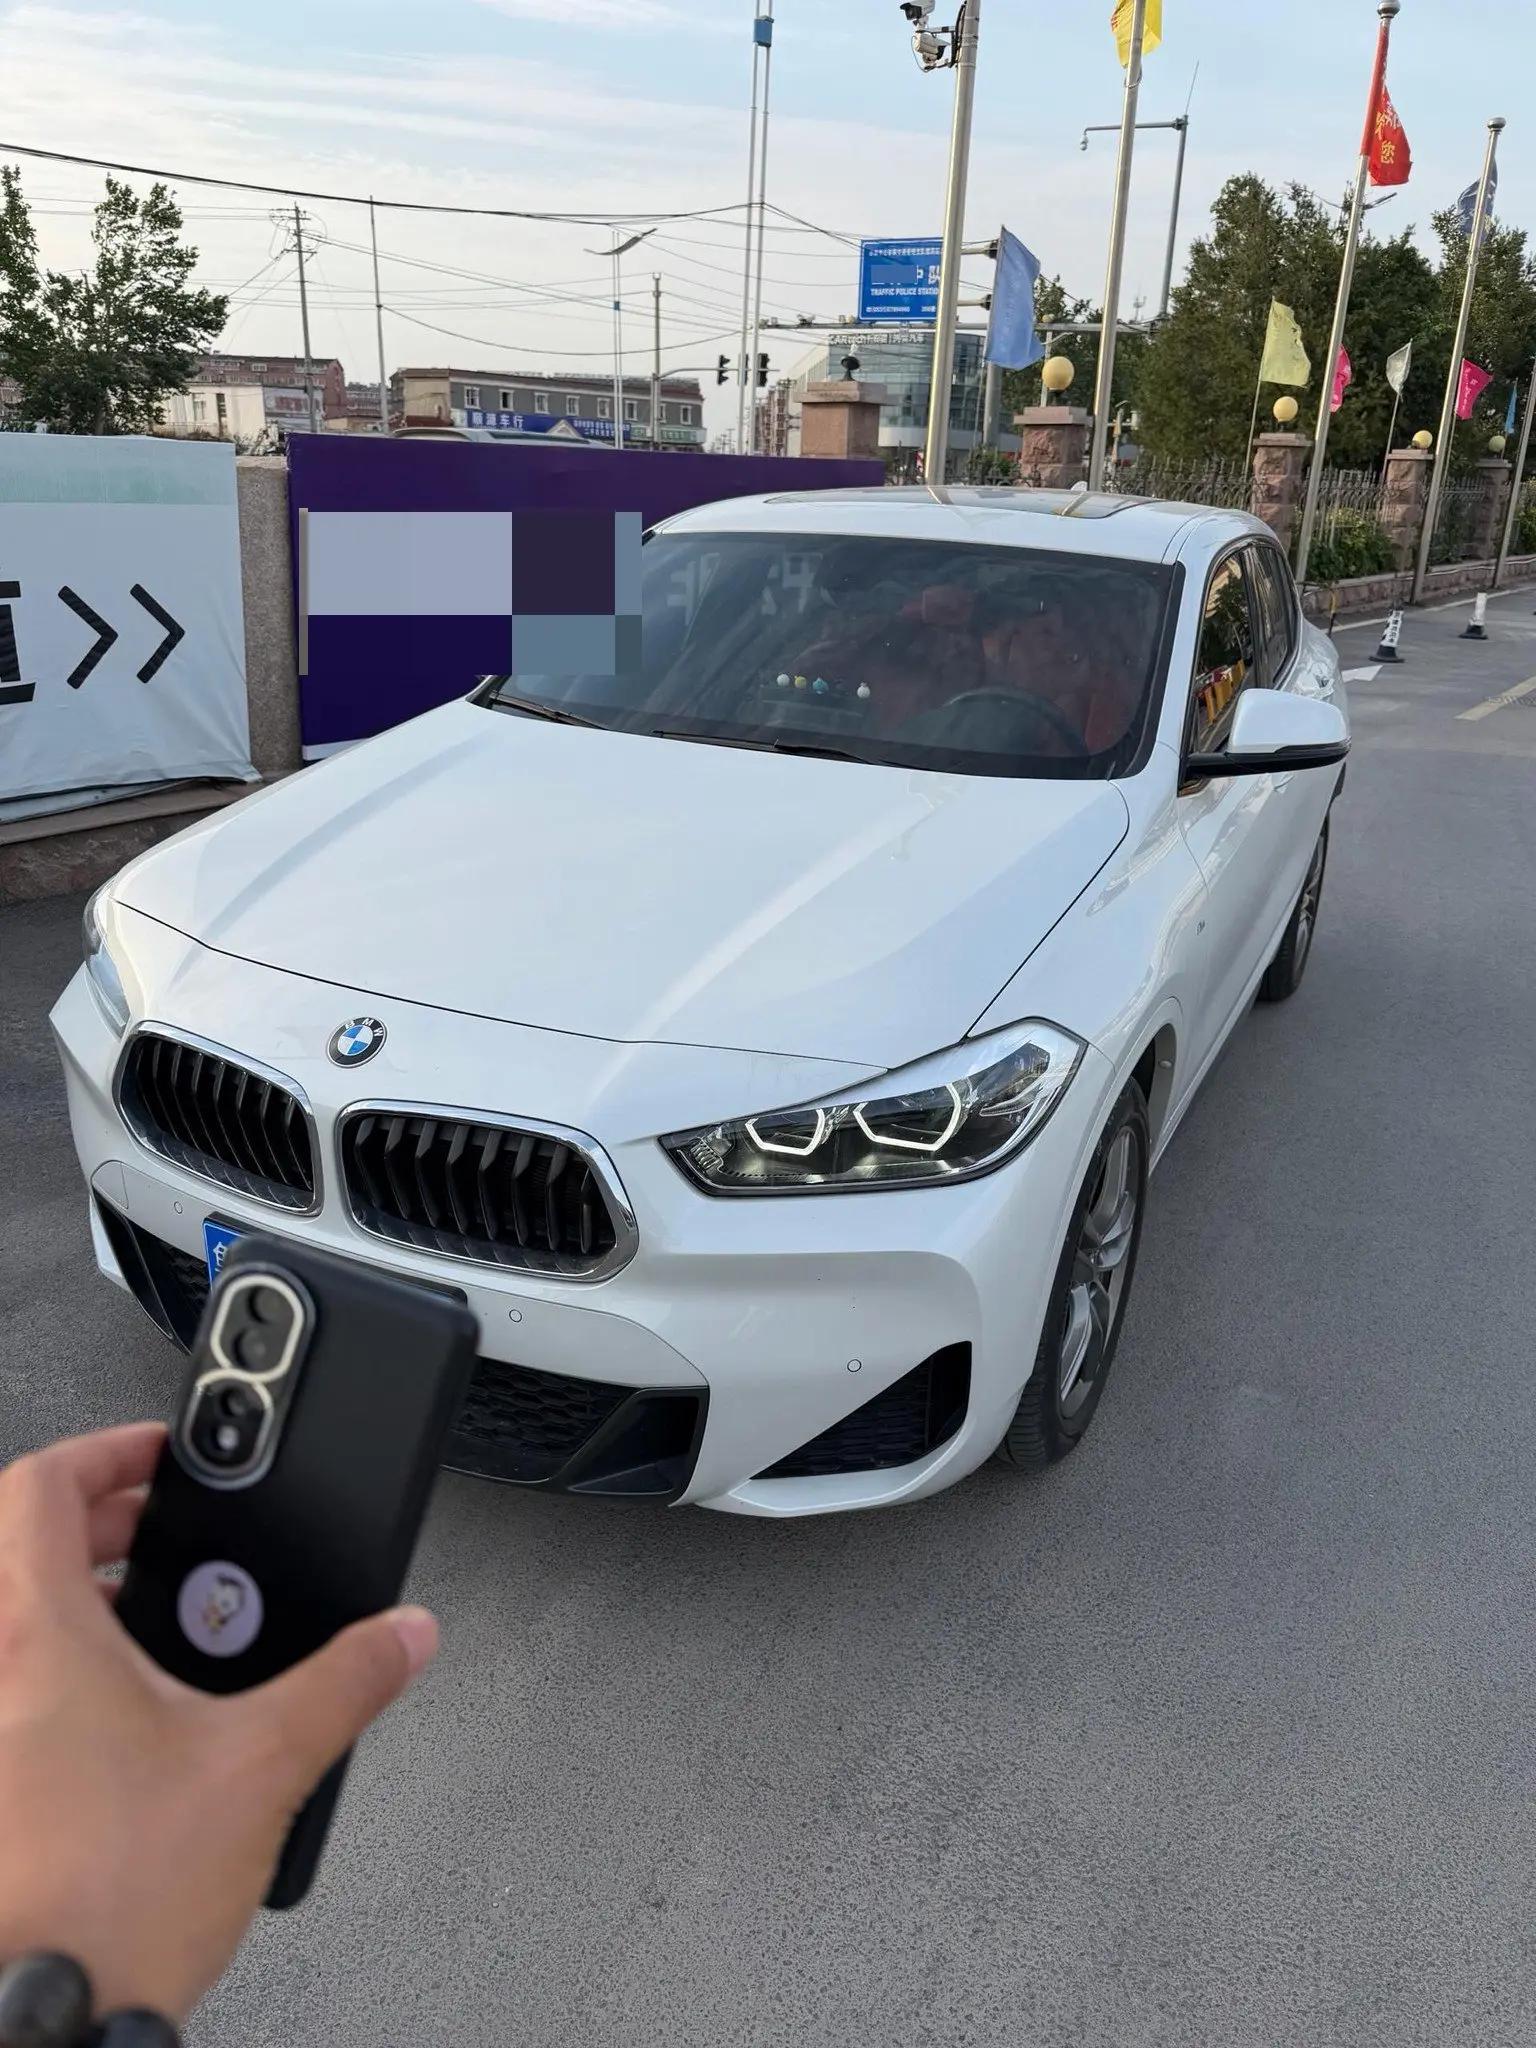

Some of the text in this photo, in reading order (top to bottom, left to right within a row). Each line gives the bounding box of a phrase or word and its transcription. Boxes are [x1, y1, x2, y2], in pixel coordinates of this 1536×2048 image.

[870, 287, 940, 296] TRAFFIC POLICE STATIO
